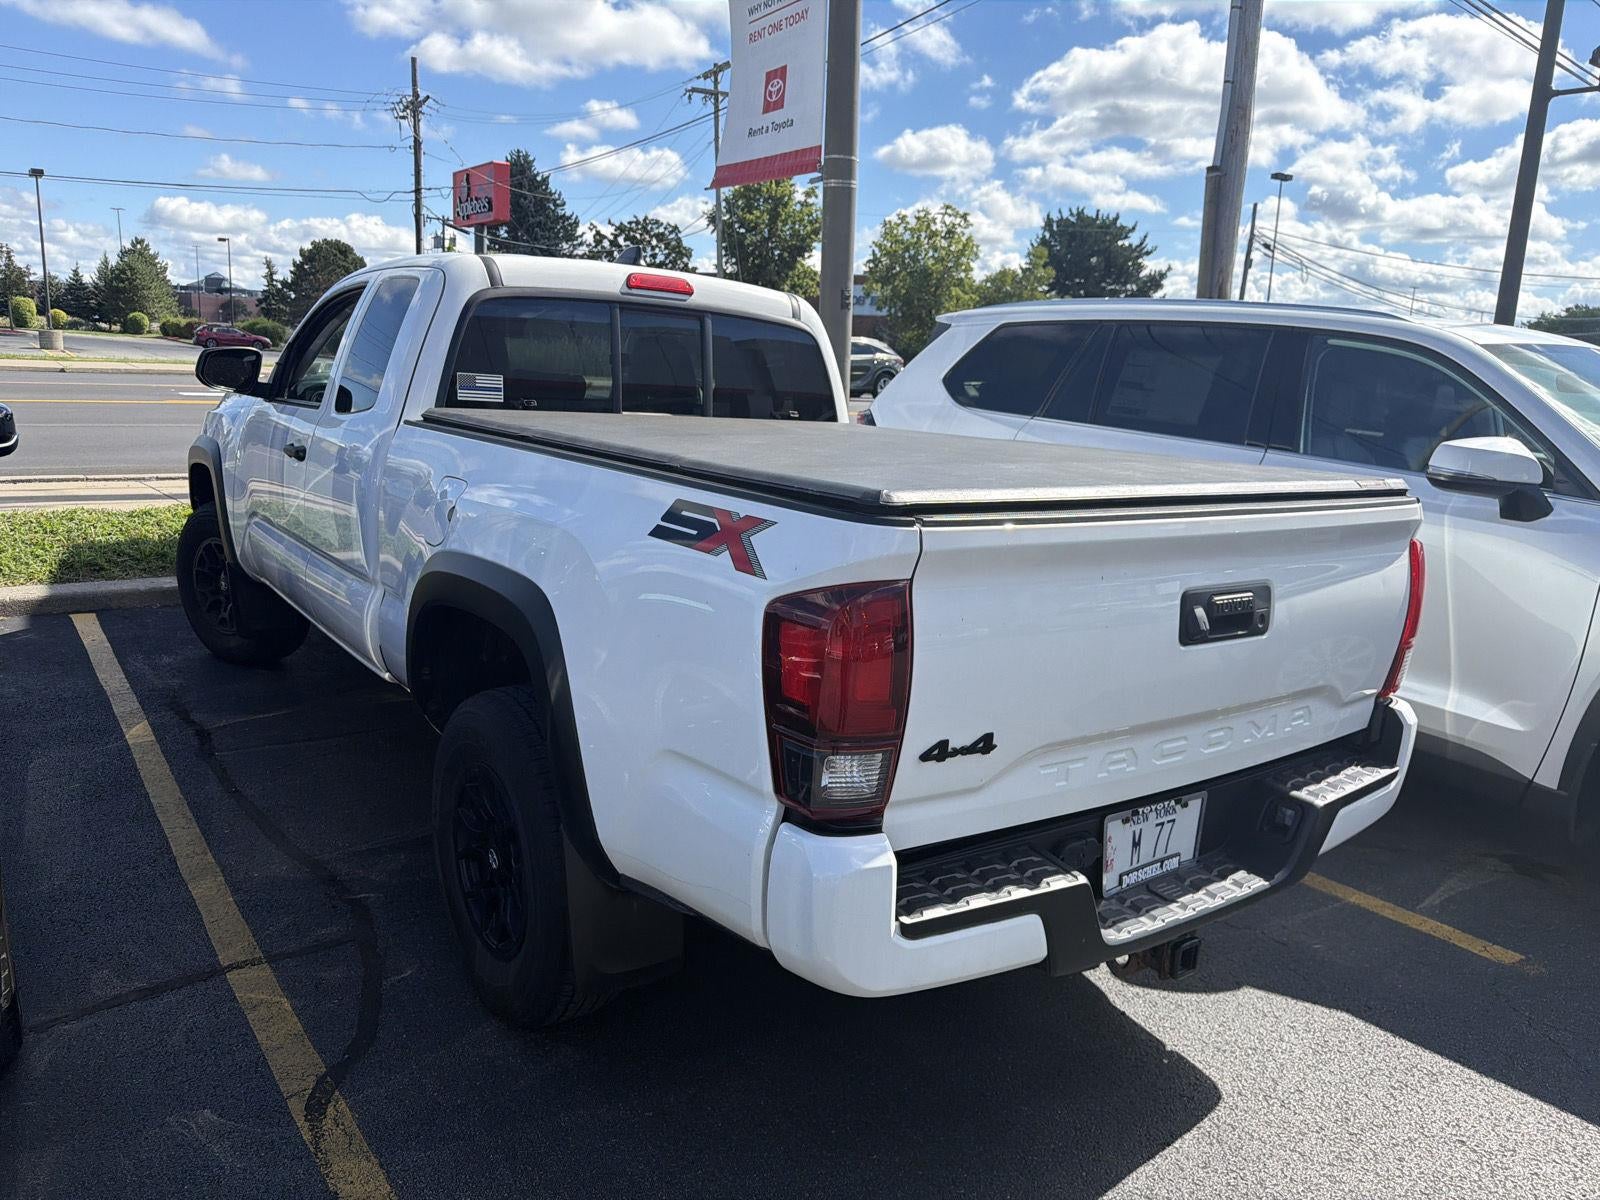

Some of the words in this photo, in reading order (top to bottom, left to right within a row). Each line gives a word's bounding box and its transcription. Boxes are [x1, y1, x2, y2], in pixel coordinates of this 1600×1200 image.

[747, 3, 763, 17] WHY
[748, 27, 766, 45] RENT
[767, 19, 783, 36] ONE
[784, 6, 811, 29] TODAY
[748, 125, 764, 138] Rent
[764, 126, 769, 134] a
[771, 118, 794, 134] Toyota
[918, 732, 997, 763] 4x4
[1040, 705, 1313, 787] TACOMA
[1130, 812, 1150, 827] NEW
[1138, 799, 1176, 815] TOYOTA
[1153, 818, 1176, 858] 77
[1121, 856, 1181, 889] DORSCHEL.COM
